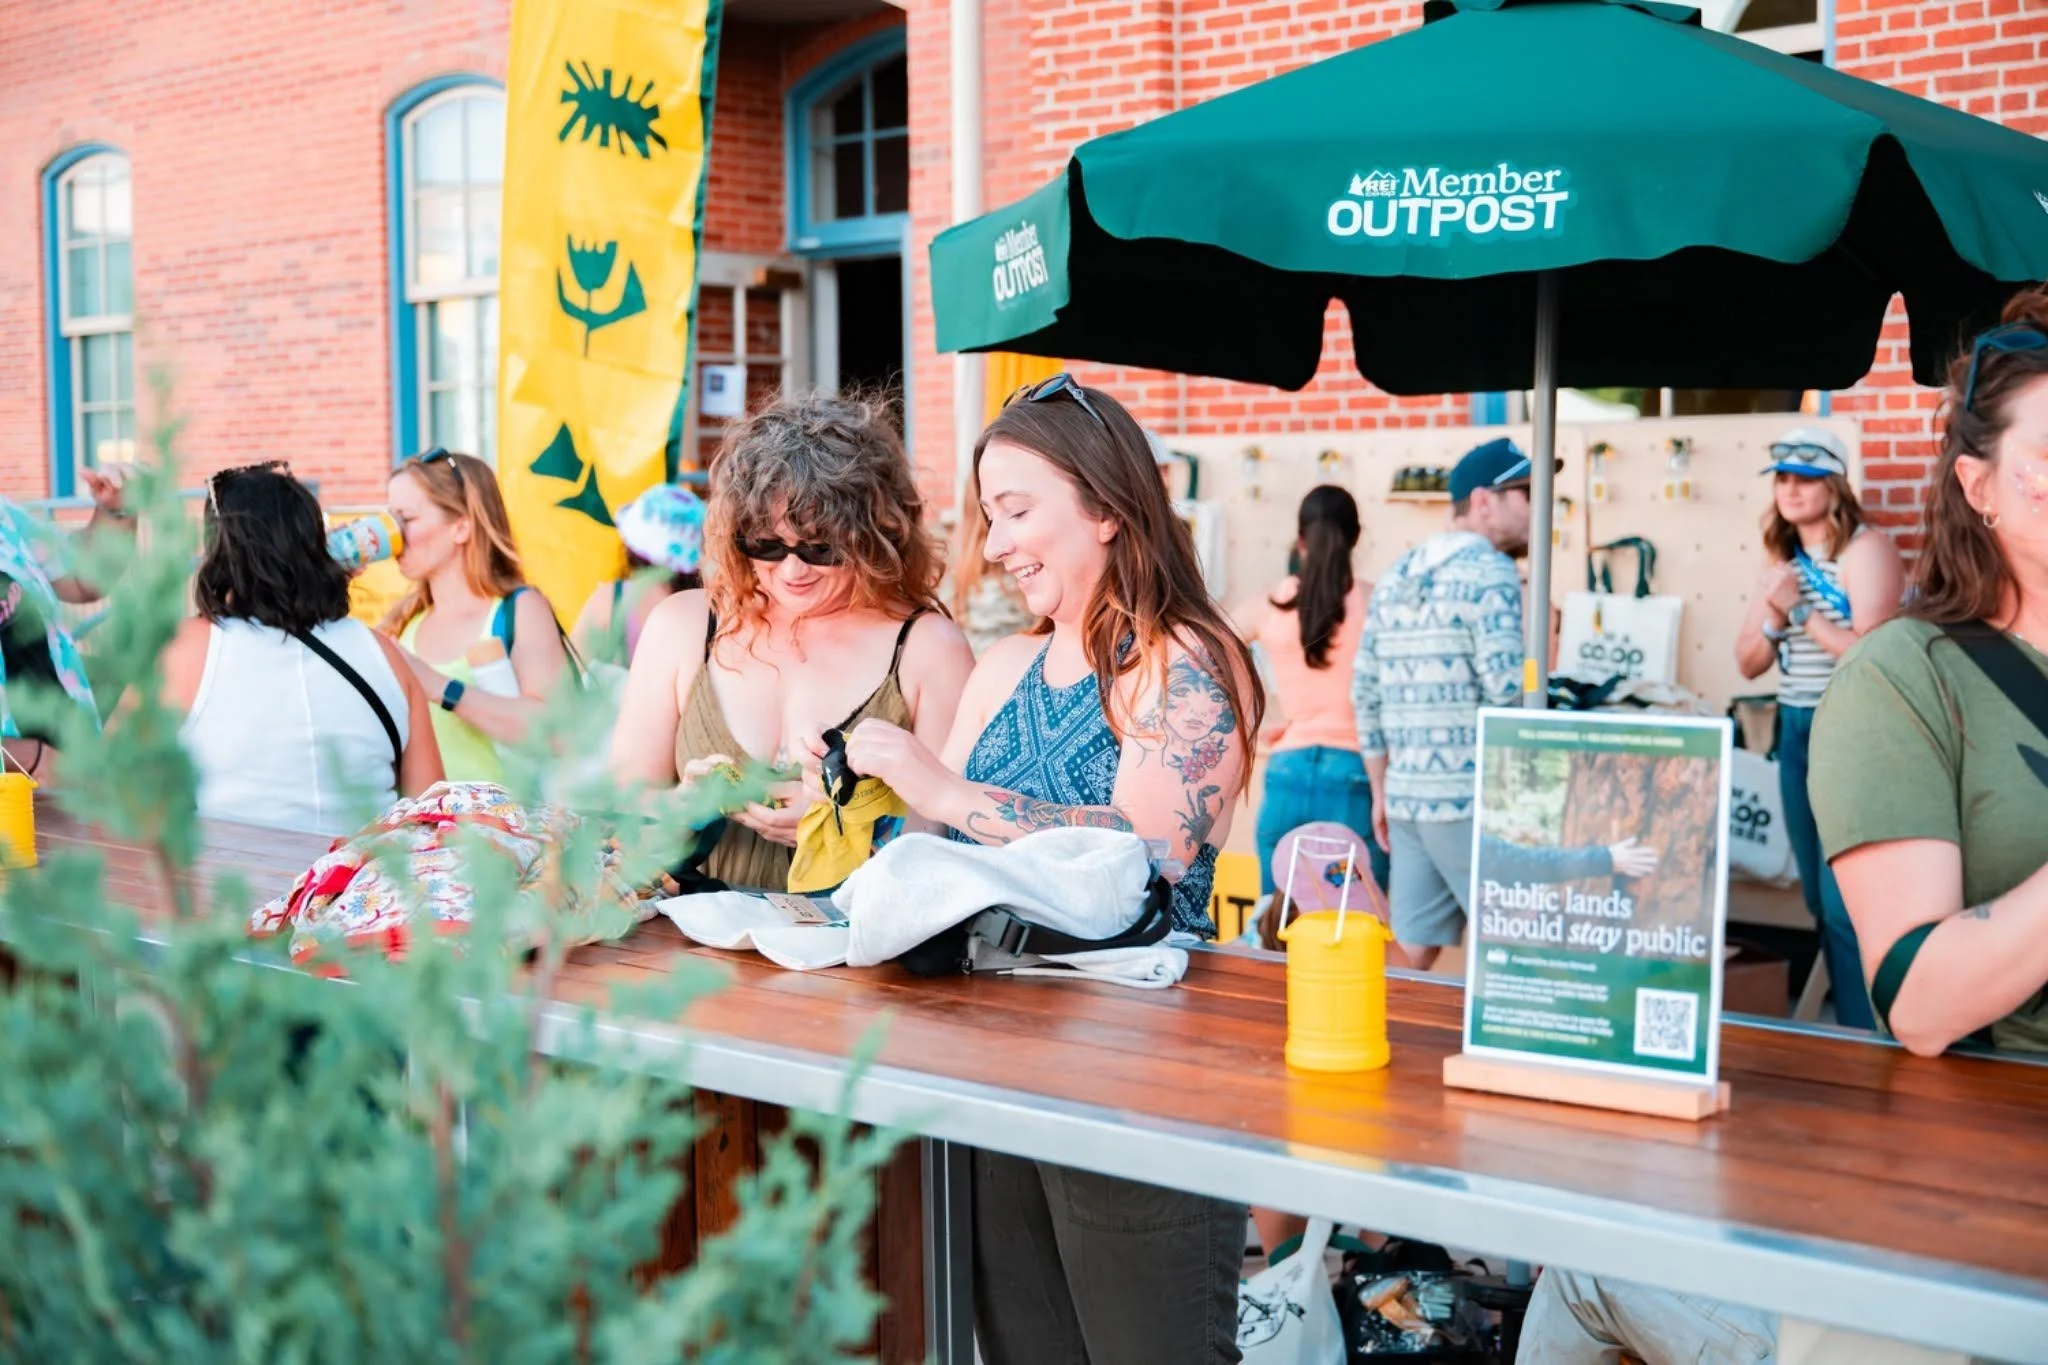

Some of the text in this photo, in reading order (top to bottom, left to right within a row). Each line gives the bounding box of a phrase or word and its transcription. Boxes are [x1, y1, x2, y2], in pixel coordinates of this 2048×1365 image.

[1400, 163, 1562, 197] Member
[1327, 191, 1569, 237] OUTPOST
[993, 244, 1048, 302] OUTPOST
[1482, 880, 1633, 919] Public lands
[1482, 910, 1707, 957] should stay public
